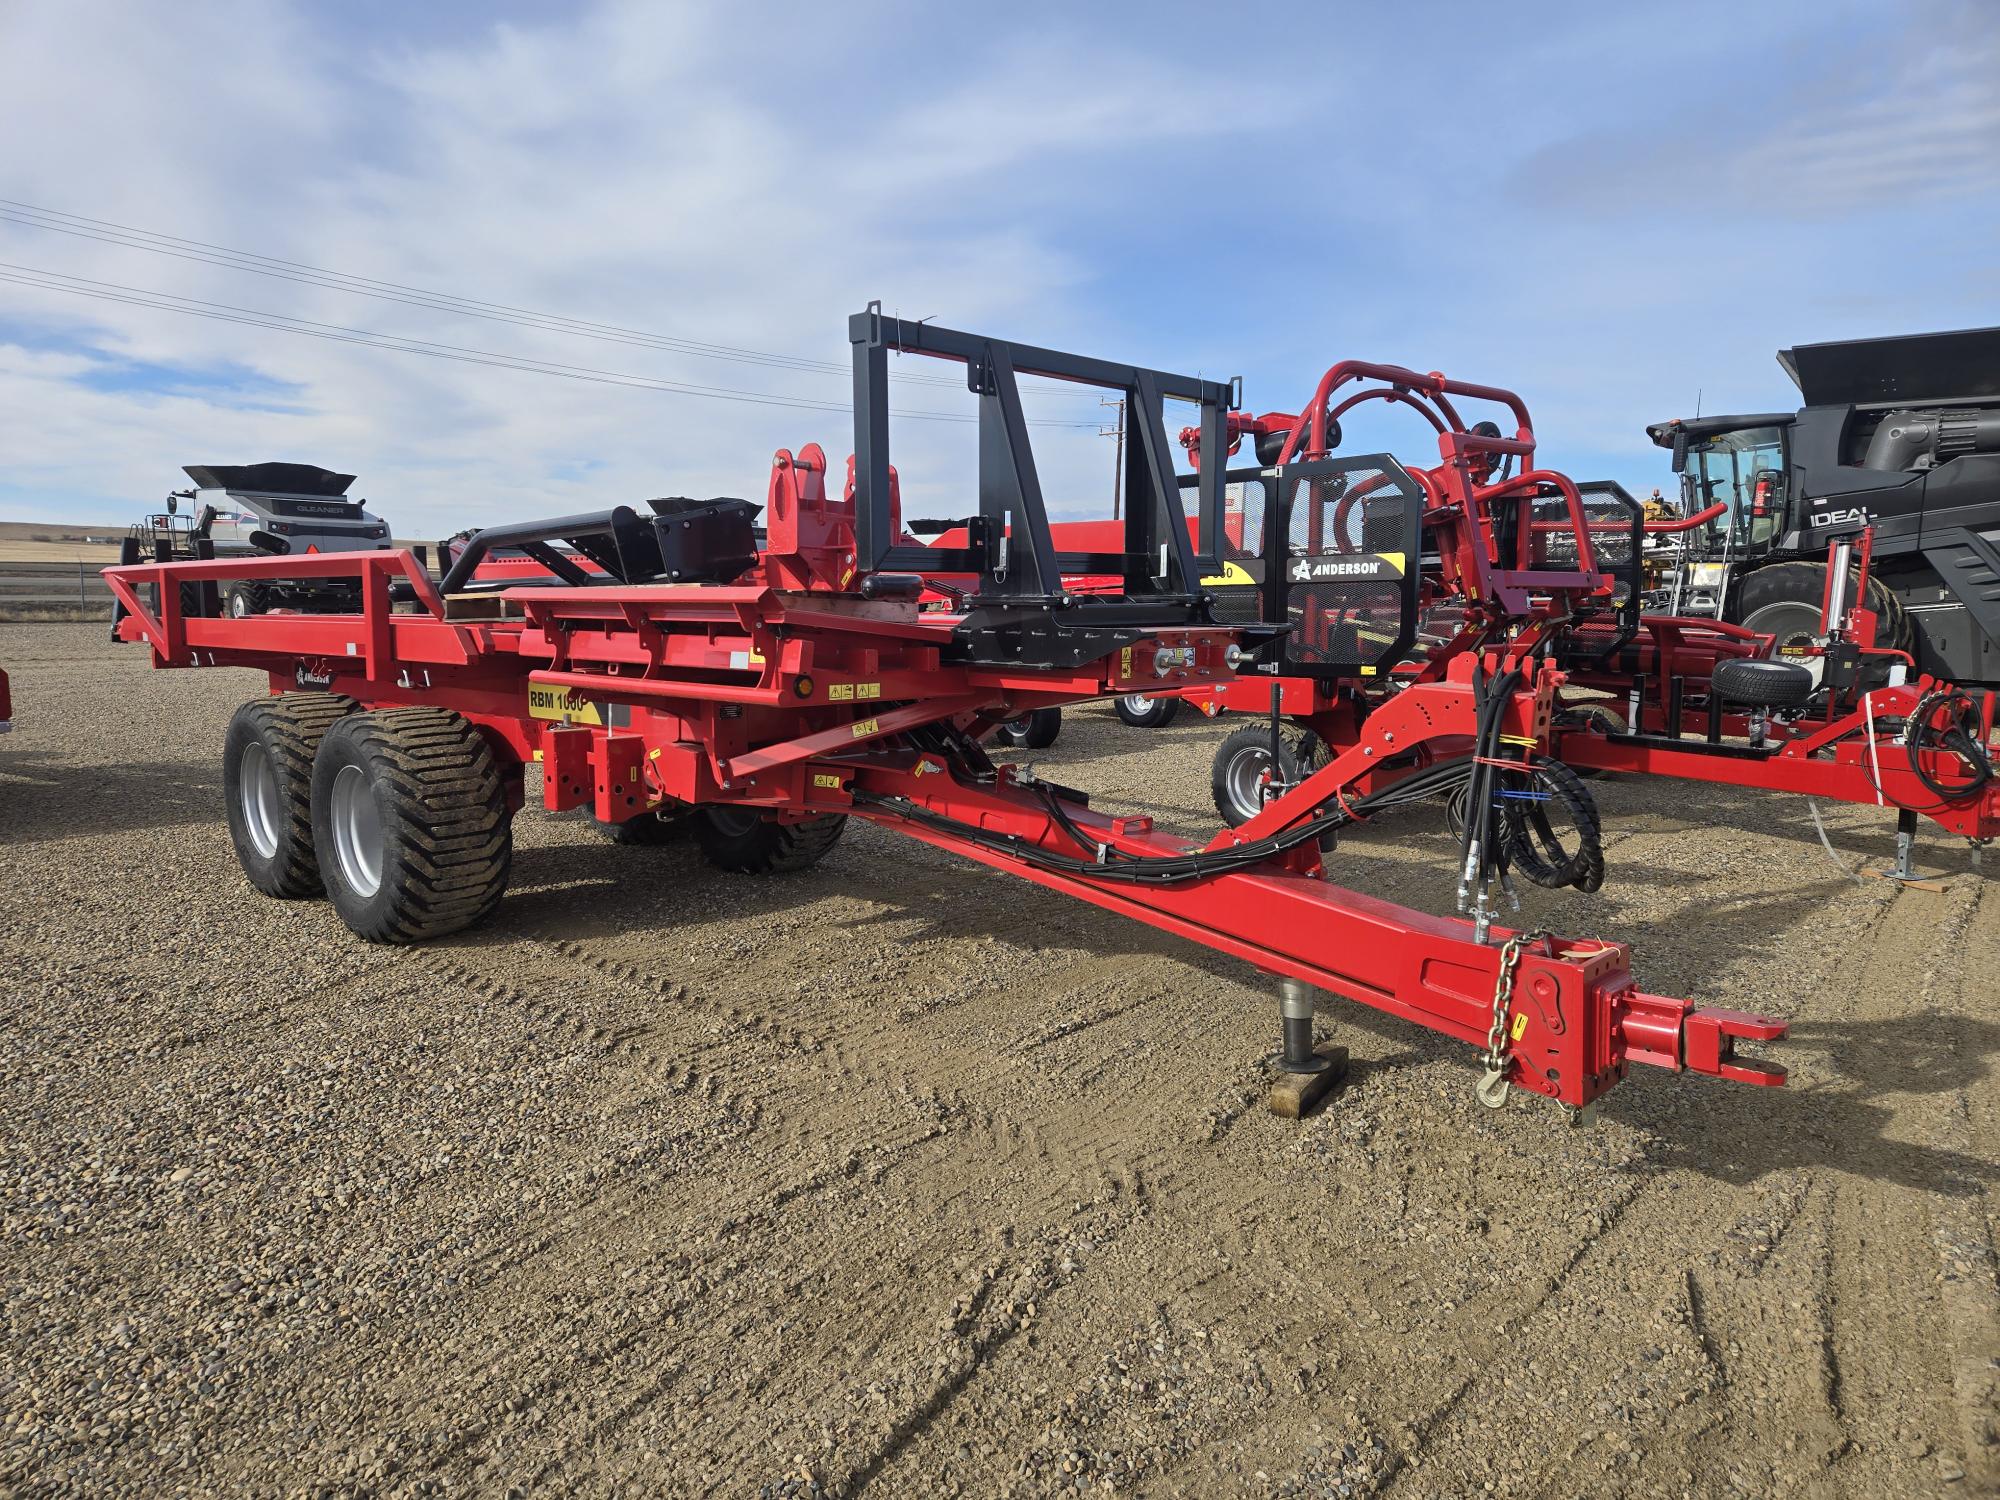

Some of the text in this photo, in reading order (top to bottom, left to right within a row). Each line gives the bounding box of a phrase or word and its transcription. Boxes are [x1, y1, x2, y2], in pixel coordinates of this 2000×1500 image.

[297, 505, 345, 514] GLEANER
[1312, 562, 1378, 577] ANDERSON
[530, 690, 554, 709] RBM
